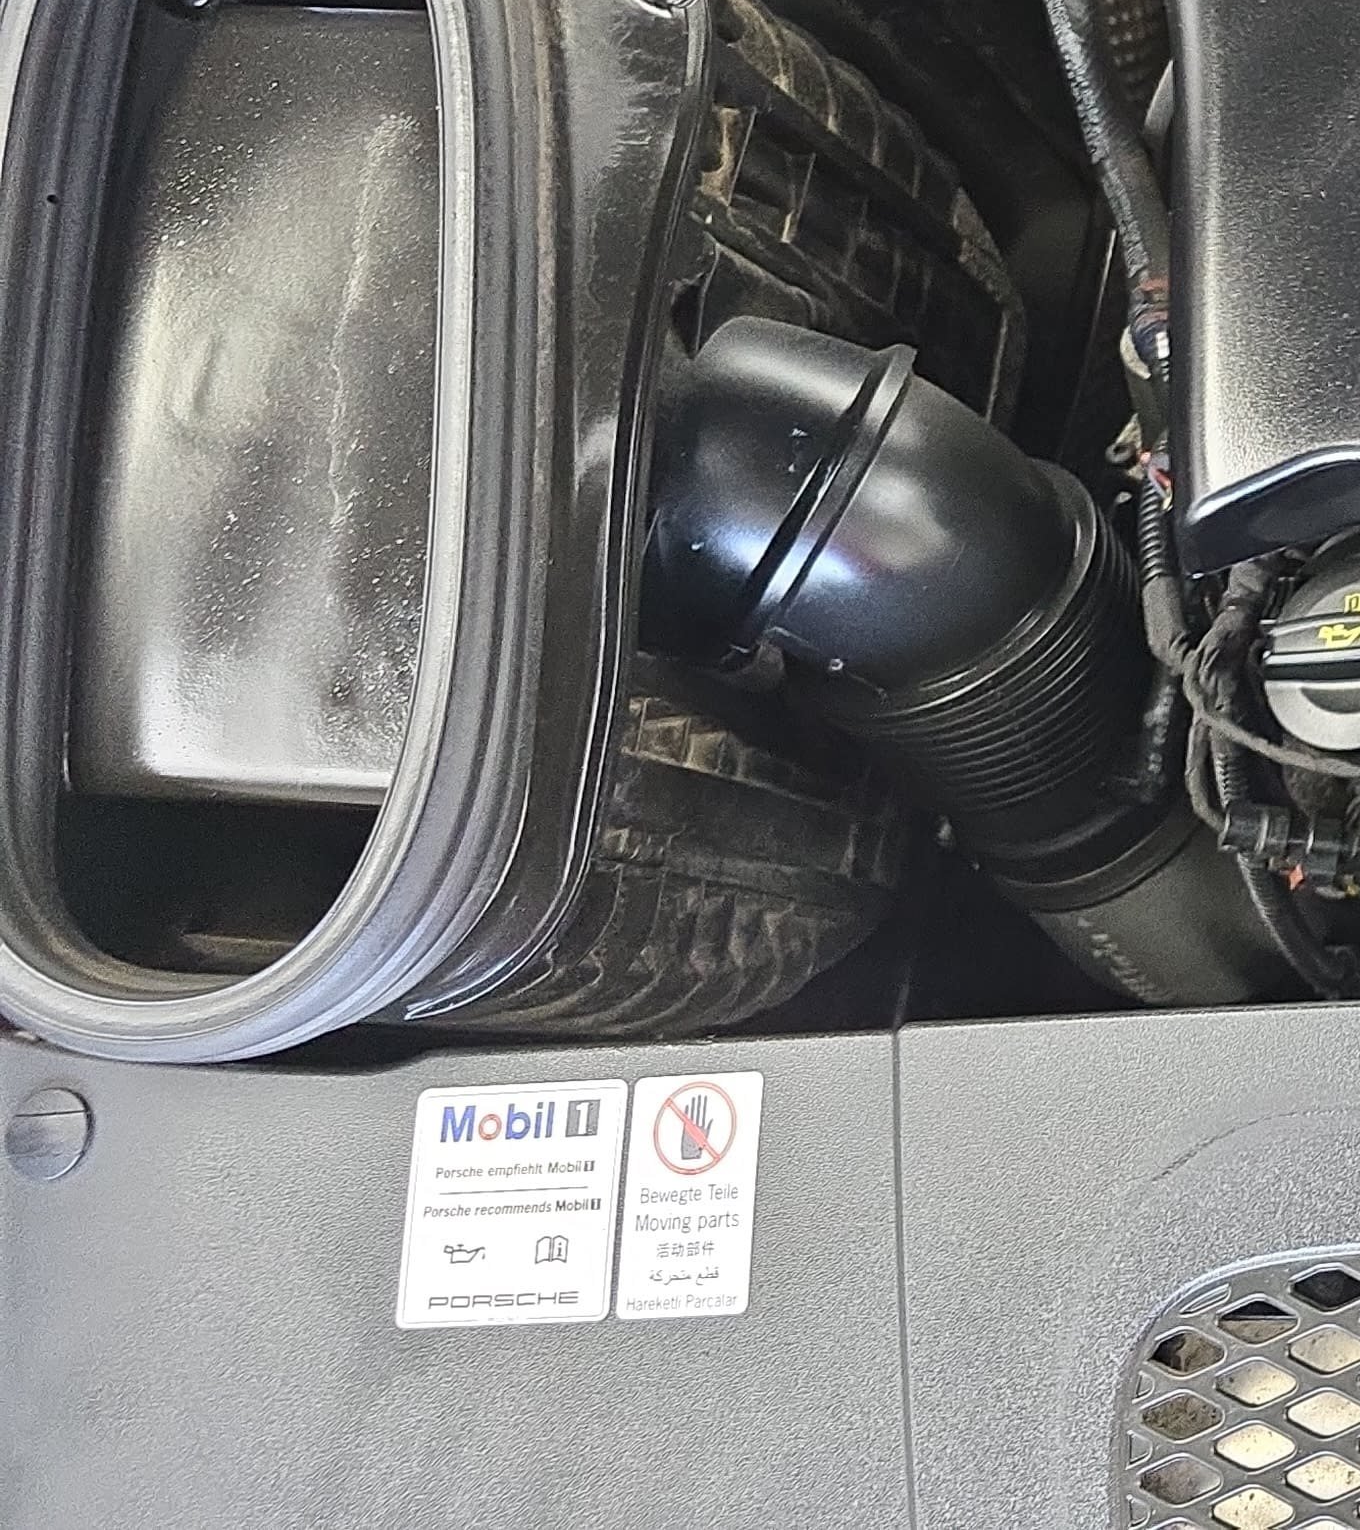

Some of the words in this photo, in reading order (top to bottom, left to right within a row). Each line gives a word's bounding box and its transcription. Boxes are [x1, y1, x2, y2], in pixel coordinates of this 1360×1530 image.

[440, 1101, 556, 1143] Mobil
[435, 1167, 483, 1179] Porsche
[487, 1163, 543, 1178] empfiehlt
[640, 1187, 702, 1205] Bewegte
[707, 1183, 739, 1200] Teile
[423, 1204, 471, 1218] Porsche
[474, 1200, 551, 1215] recommends
[635, 1214, 692, 1234] Moving
[697, 1210, 740, 1232] parts
[428, 1291, 580, 1310] PORSCHE
[626, 1295, 682, 1311] Hareketli
